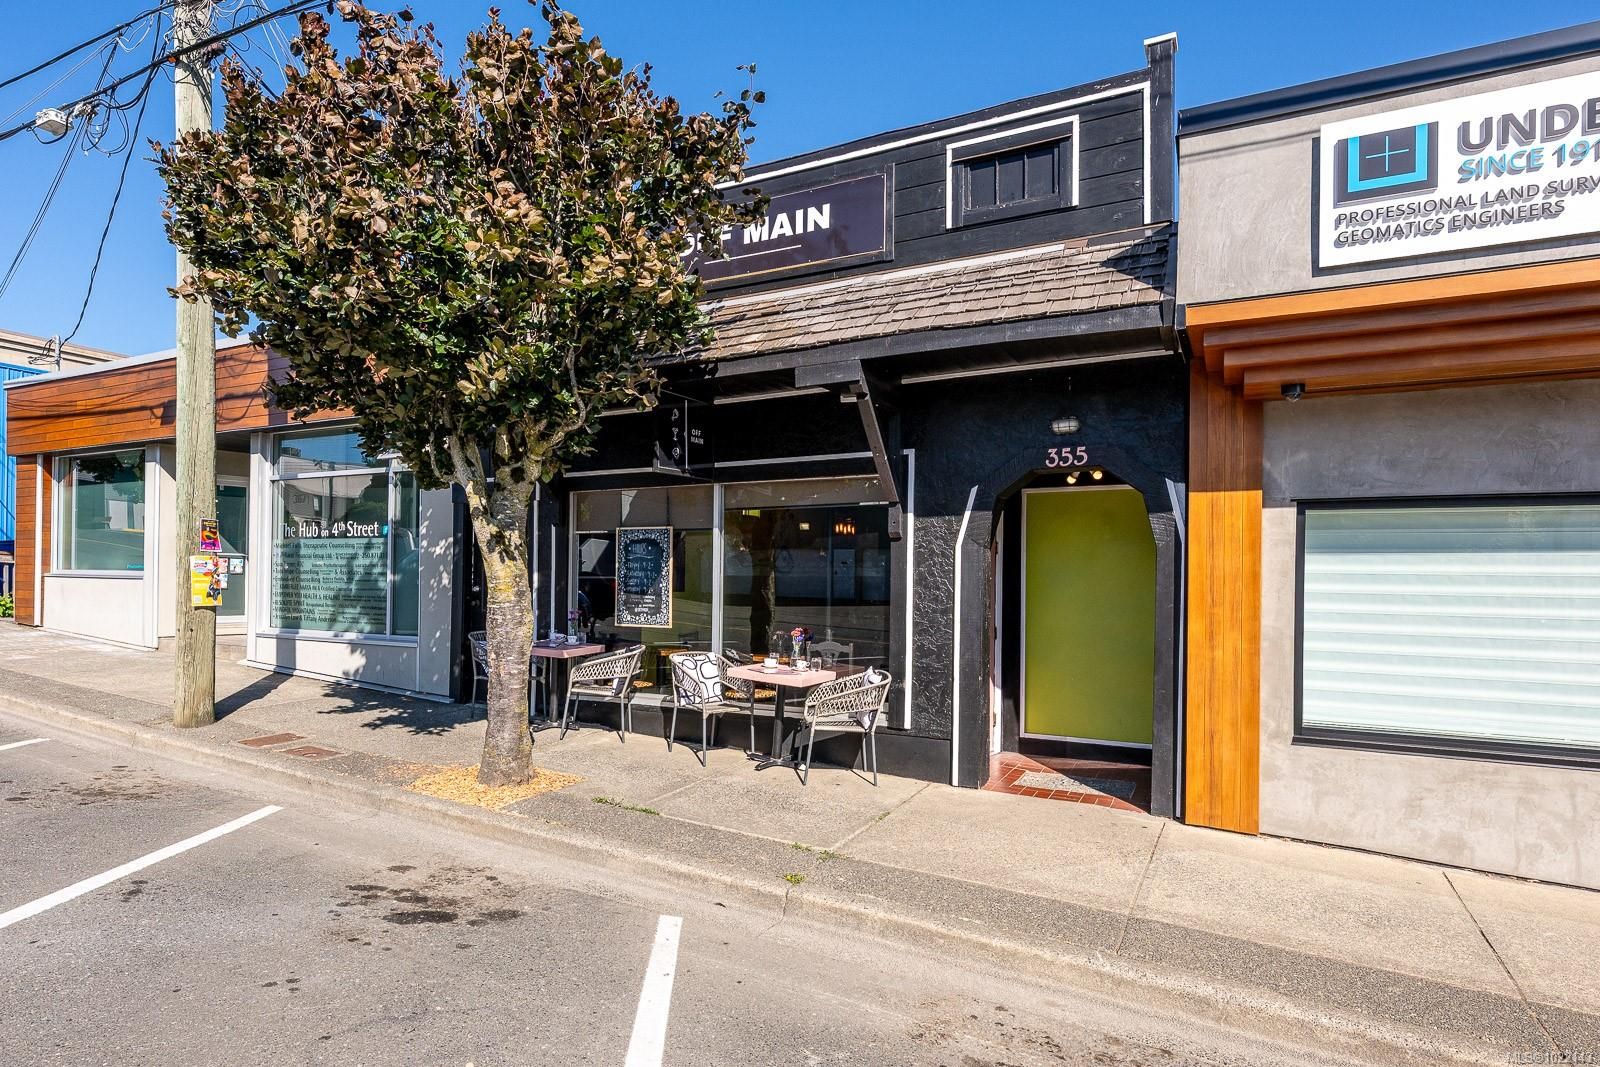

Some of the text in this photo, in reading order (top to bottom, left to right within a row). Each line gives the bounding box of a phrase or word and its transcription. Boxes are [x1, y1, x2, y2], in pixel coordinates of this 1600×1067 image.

[1458, 147, 1544, 183] SINCE
[743, 203, 831, 245] MAIN
[1334, 200, 1565, 248] GEOMATICS ENGINEERS
[1335, 194, 1478, 230] PROFESSIONAL
[1481, 184, 1540, 208] LAND
[1045, 446, 1088, 468] 355
[299, 521, 319, 538] Hub
[347, 520, 379, 537] Street
